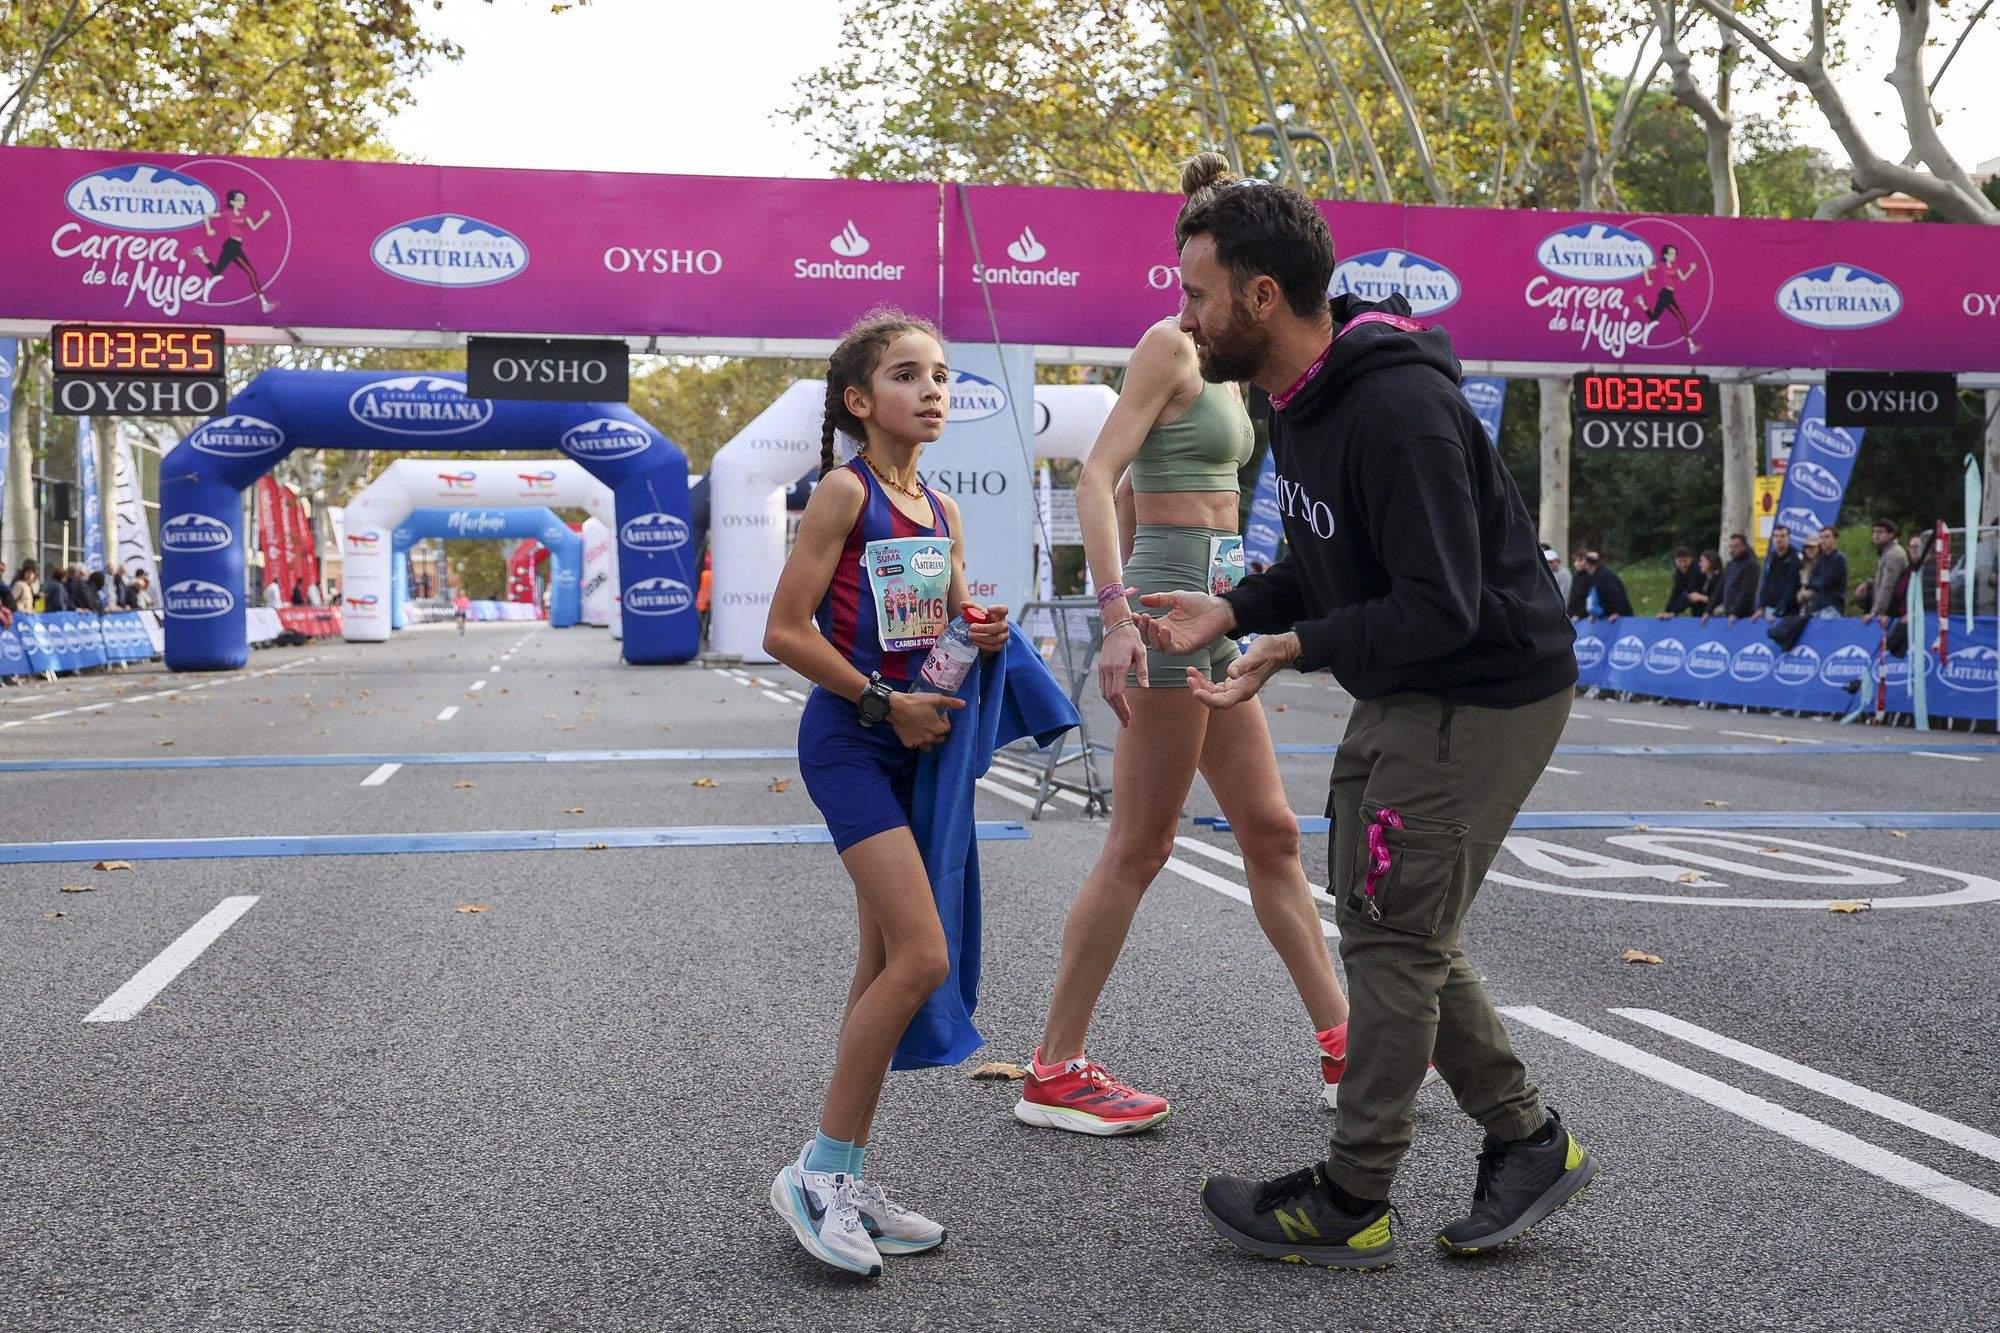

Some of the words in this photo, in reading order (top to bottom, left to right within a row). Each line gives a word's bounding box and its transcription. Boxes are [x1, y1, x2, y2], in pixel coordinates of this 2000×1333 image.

[79, 187, 205, 215] ASTURIANA
[52, 223, 178, 261] Carrera
[385, 241, 516, 269] ASTURIANA
[1546, 244, 1644, 267] ASTURIANA
[604, 247, 722, 275] OYSHO
[794, 258, 905, 281] Santander
[82, 261, 106, 284] de
[111, 262, 128, 286] la
[124, 260, 223, 316] Mujer
[972, 264, 1080, 287] Santander
[1525, 276, 1623, 310] Carrera
[1786, 287, 1892, 312] ASTURIANA
[1548, 309, 1570, 331] de
[1571, 310, 1585, 332] la
[1581, 306, 1659, 358] Mujer
[62, 332, 213, 369] 00:32:55
[493, 358, 607, 384] OYSHO
[61, 380, 219, 412] OYSHO
[362, 393, 480, 421] ASTURIANA
[949, 396, 998, 410] RIANA
[1585, 377, 1703, 412] 00:32:55
[1846, 390, 1939, 413] OYSHO
[198, 431, 277, 447] ASTURIANA
[751, 439, 810, 451] OYSHO
[1583, 419, 1704, 449] OYSHO
[917, 470, 1006, 495] YSHO
[876, 554, 901, 564] SUMA
